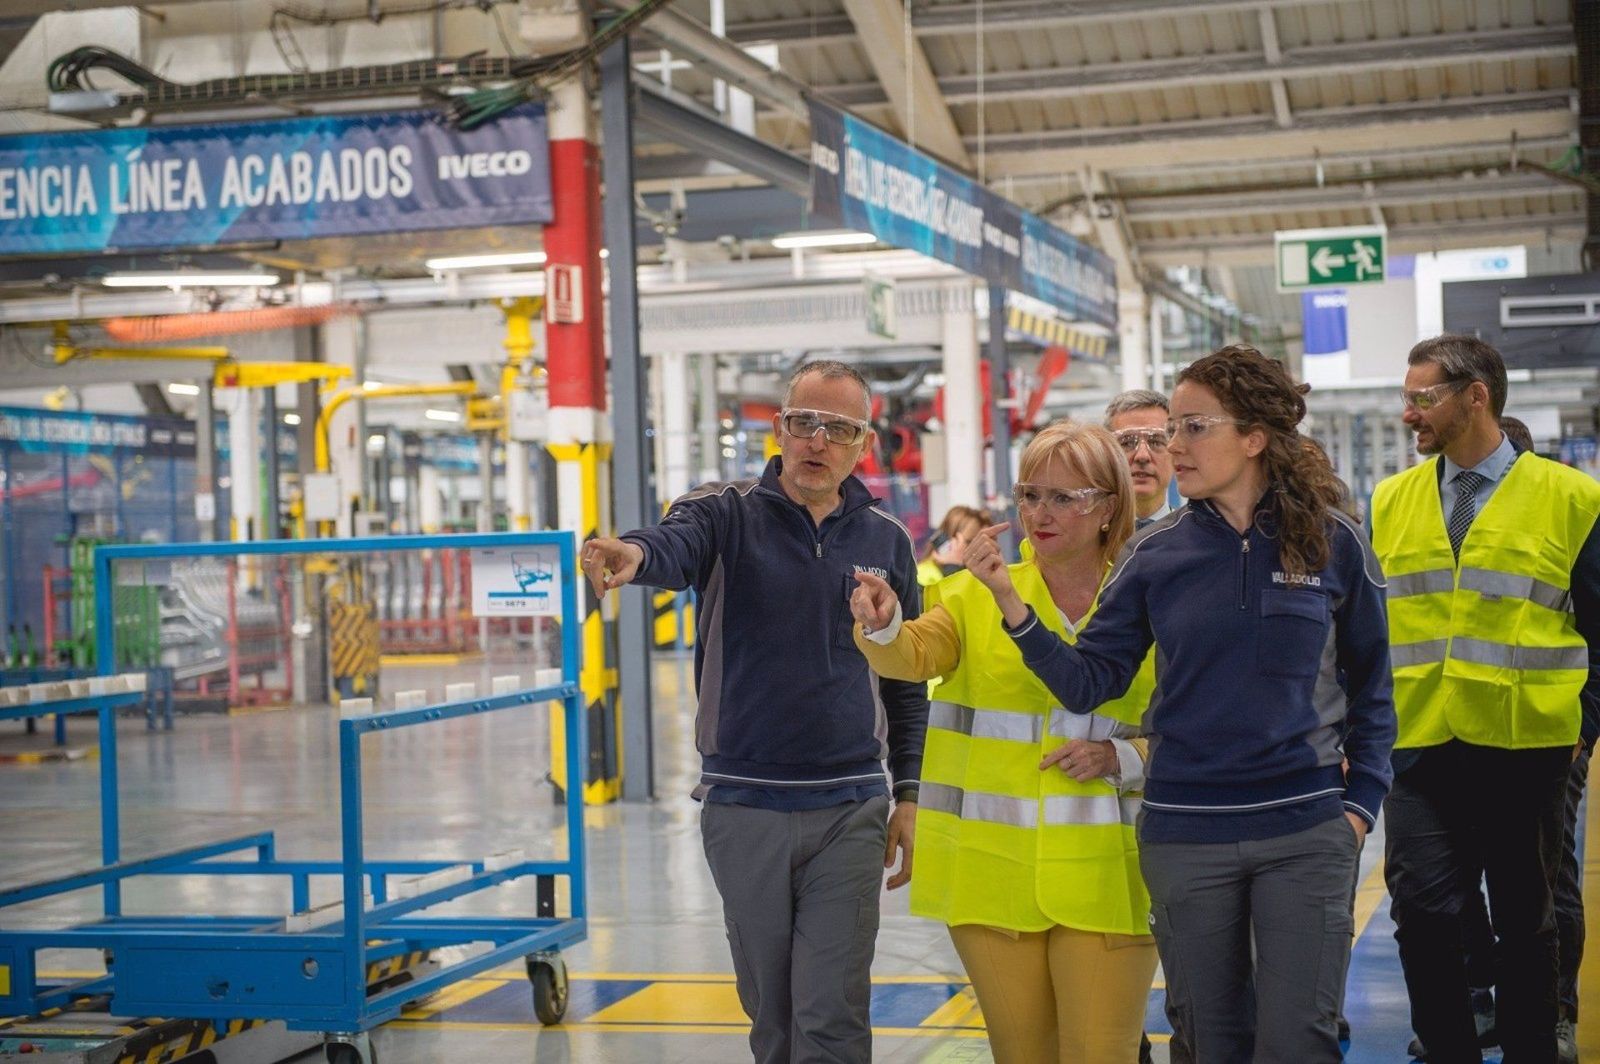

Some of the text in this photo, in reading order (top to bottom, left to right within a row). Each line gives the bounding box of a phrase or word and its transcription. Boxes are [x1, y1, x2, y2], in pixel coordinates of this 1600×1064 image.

[0, 145, 532, 220] ENCIA LÍNEA ACABADOS IVECO
